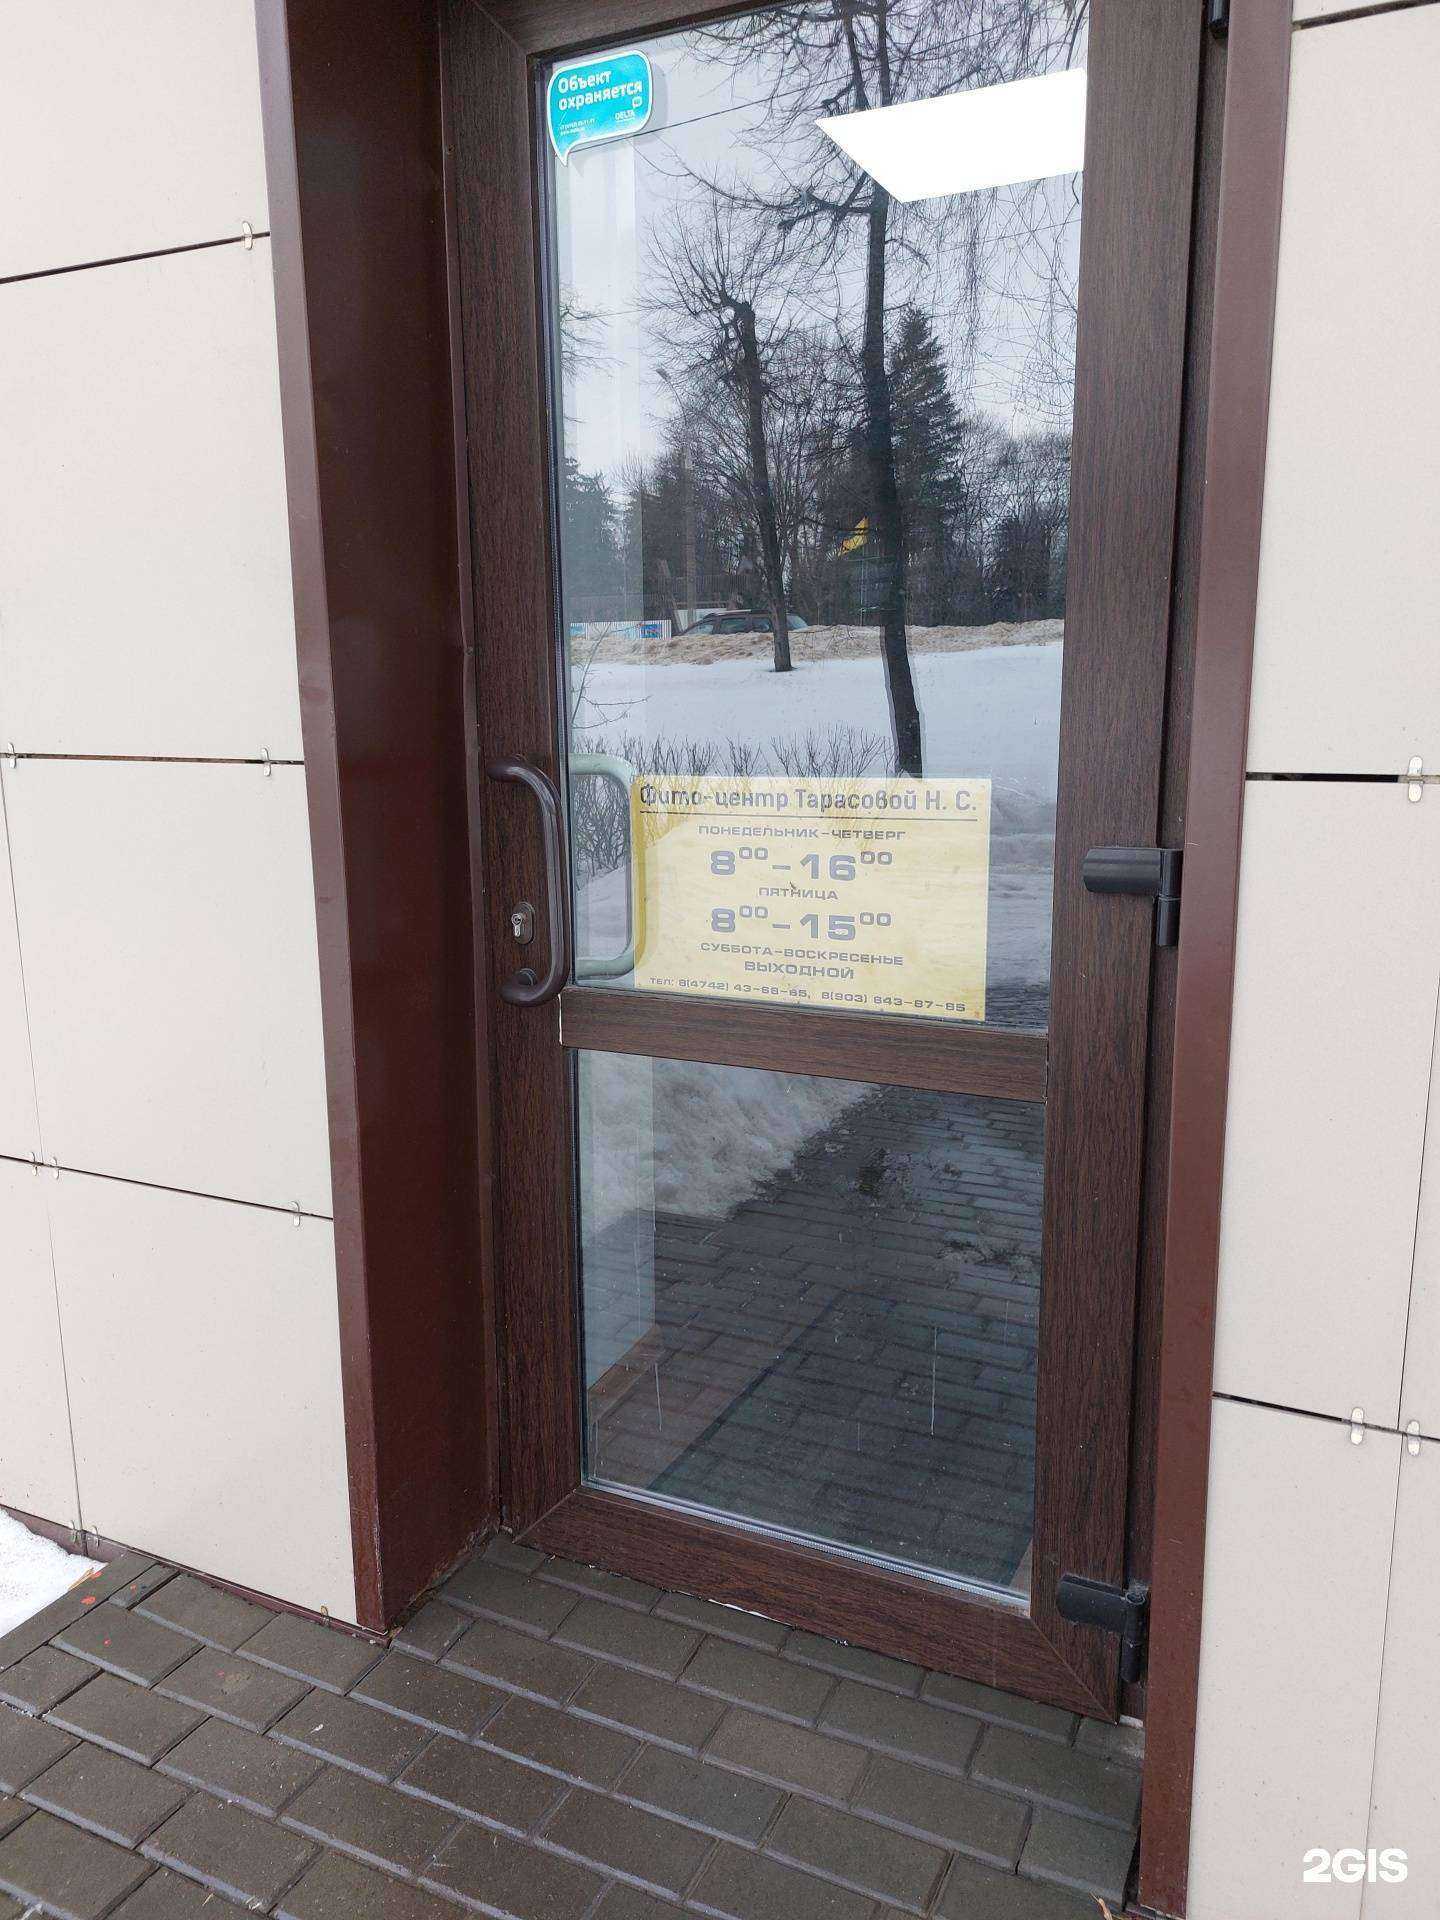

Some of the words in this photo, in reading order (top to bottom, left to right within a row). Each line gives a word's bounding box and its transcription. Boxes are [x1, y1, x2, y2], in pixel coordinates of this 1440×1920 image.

[558, 71, 612, 93] Объект
[558, 80, 643, 110] охраняется
[795, 788, 917, 813] Тарасовой
[758, 887, 838, 900] ПЯТНИЦА
[744, 960, 855, 979] ВЫХОДНОЙ
